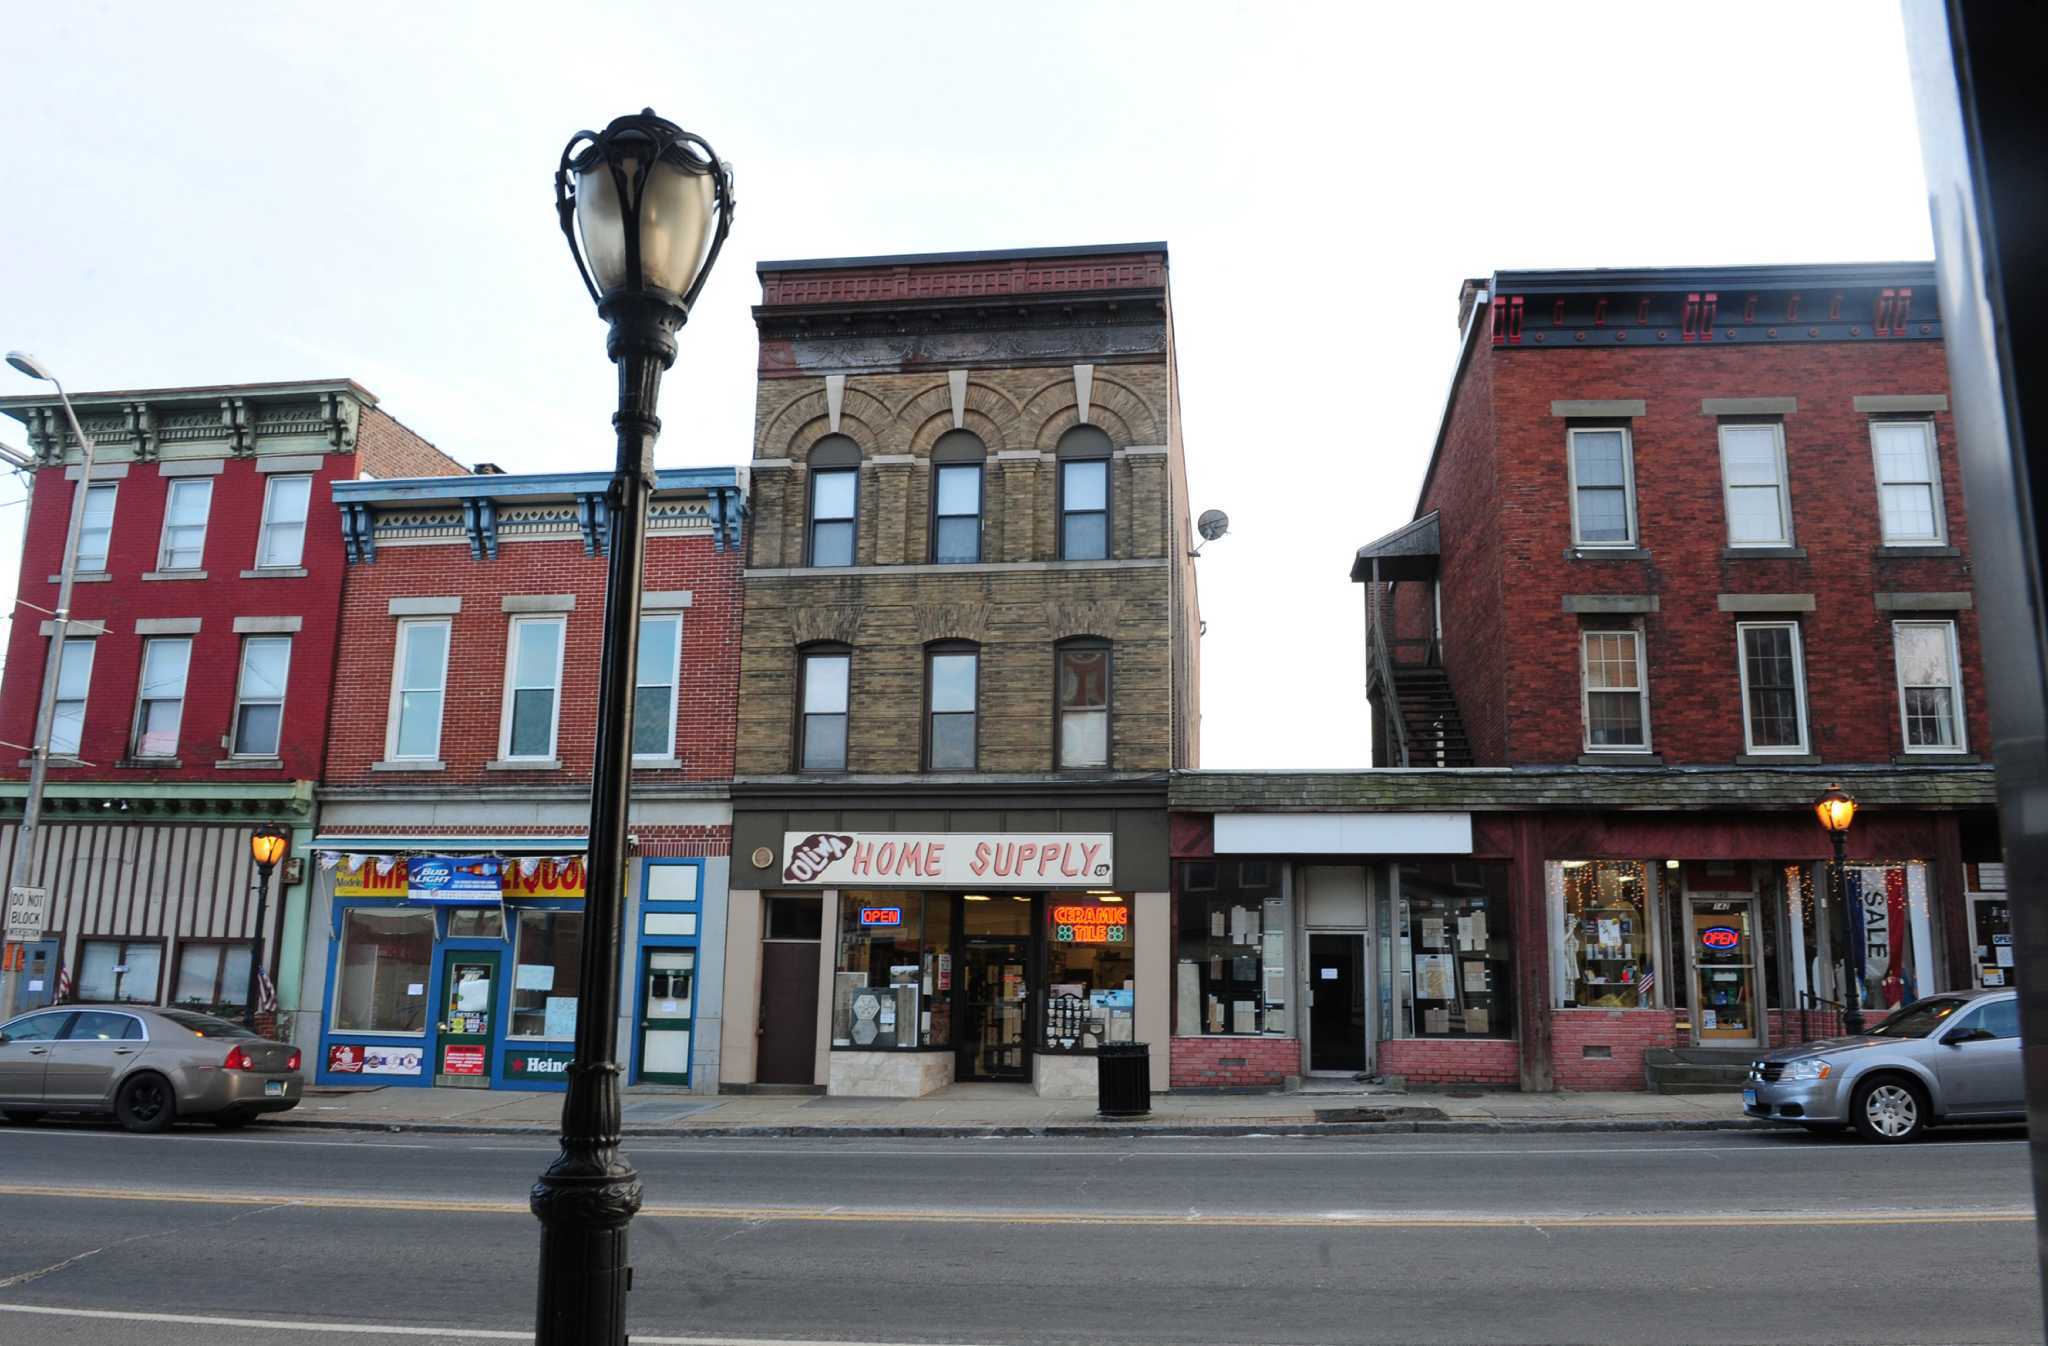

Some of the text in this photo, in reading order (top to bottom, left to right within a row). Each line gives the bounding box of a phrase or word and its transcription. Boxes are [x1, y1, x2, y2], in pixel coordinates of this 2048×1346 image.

[852, 841, 945, 877] HOME
[969, 841, 1102, 877] SUPPLY
[11, 893, 44, 907] DO NOT
[11, 911, 40, 925] BLOCK
[863, 910, 899, 923] OPEN
[1054, 907, 1128, 925] CERAMIC
[1073, 924, 1107, 942] TILE
[1864, 891, 1888, 959] SALE
[1703, 931, 1738, 945] OPEN
